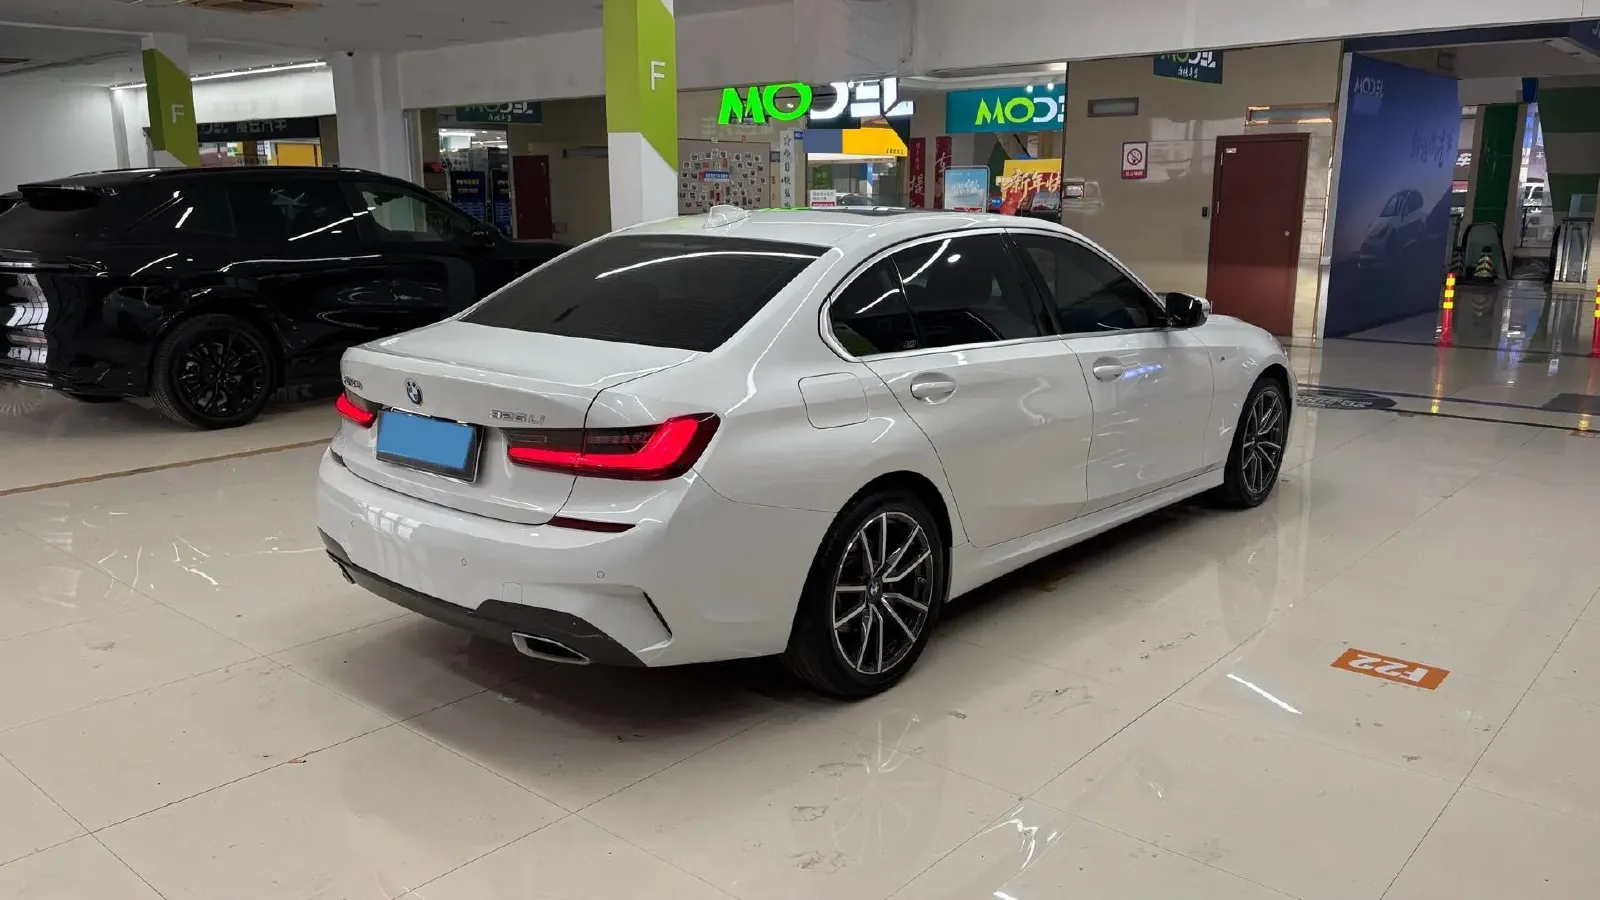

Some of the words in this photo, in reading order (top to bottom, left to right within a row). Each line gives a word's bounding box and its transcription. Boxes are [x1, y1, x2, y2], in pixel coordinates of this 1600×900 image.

[650, 60, 666, 91] F
[171, 104, 185, 123] F
[718, 78, 914, 125] MODEL
[1347, 654, 1429, 683] F22
